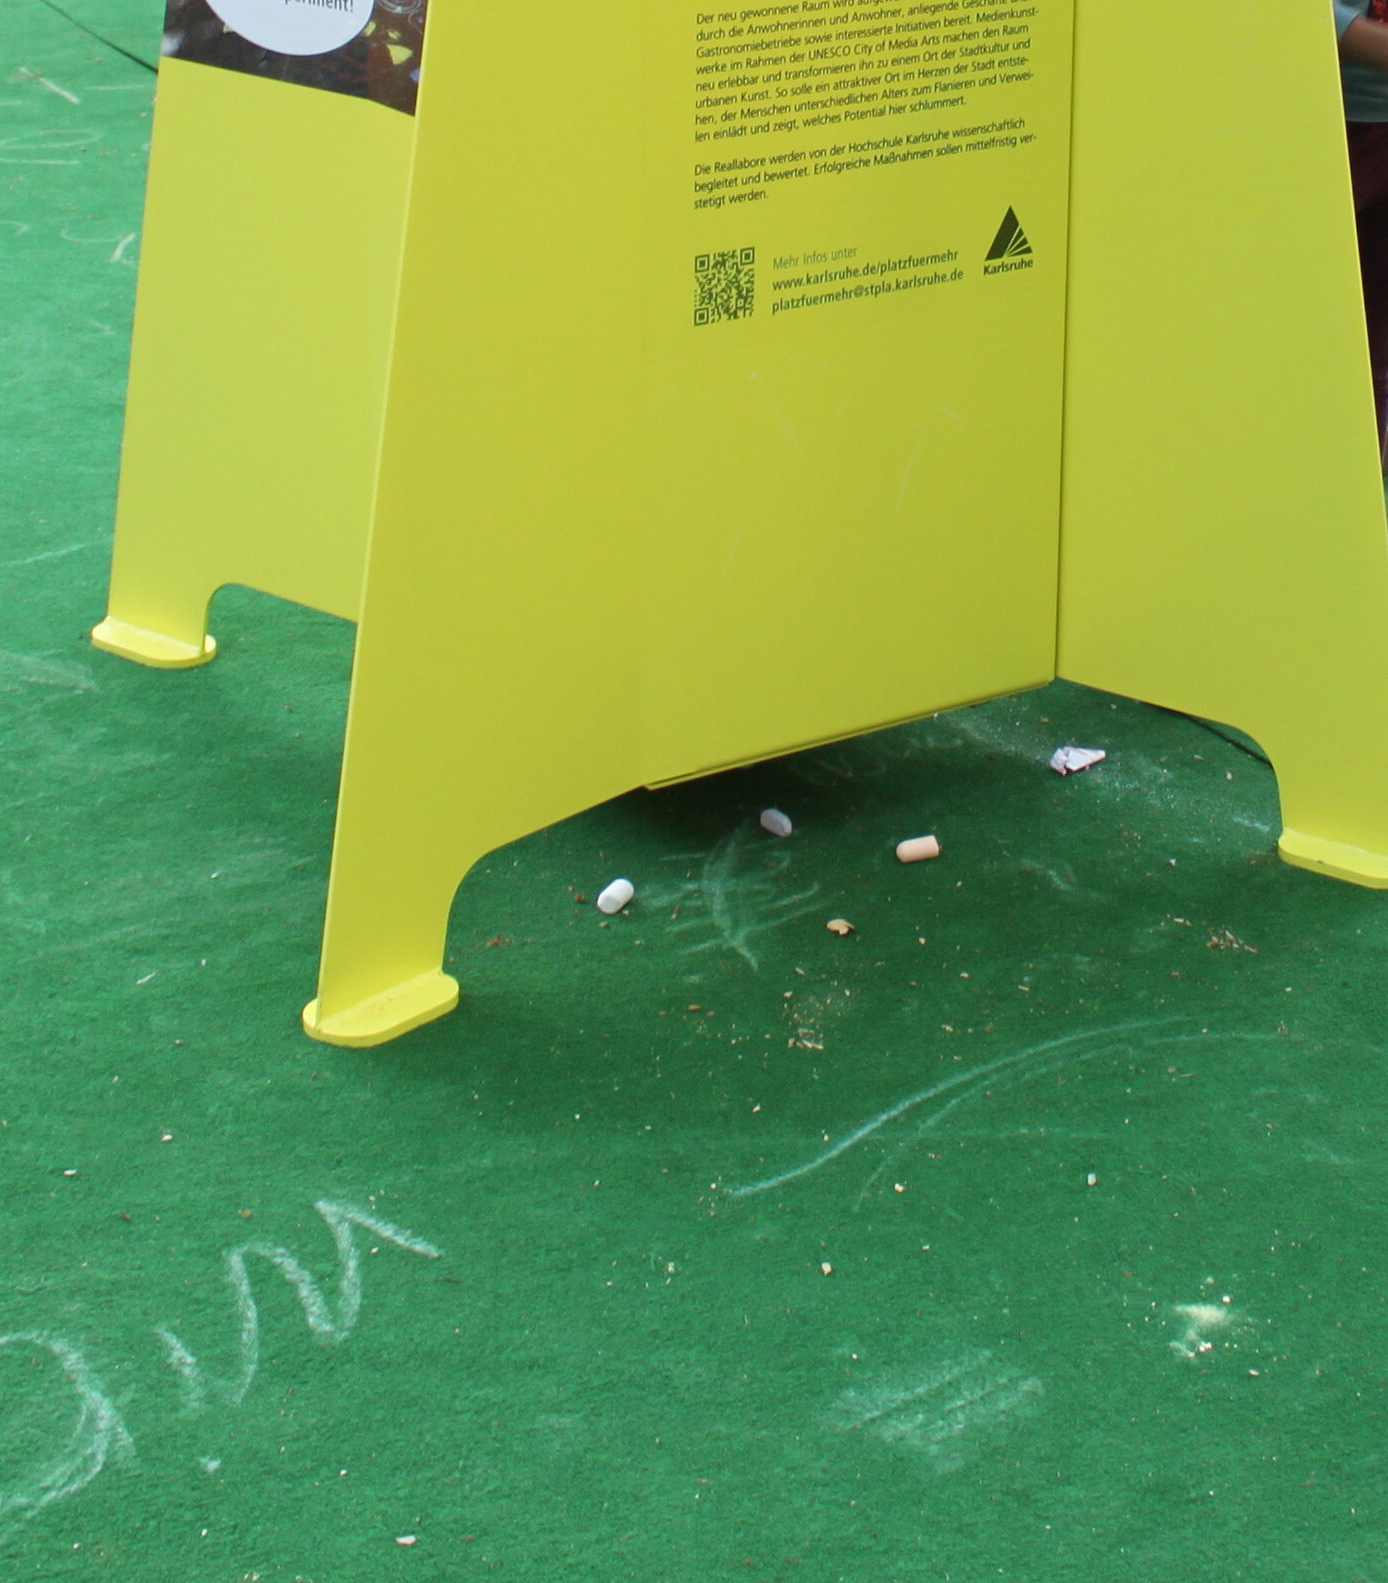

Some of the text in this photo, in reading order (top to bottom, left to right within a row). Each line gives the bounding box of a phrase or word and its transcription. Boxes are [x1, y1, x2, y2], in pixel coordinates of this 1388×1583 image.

[696, 12, 715, 25] Der
[717, 12, 737, 22] neu
[739, 4, 799, 22] gewonnene
[801, 0, 830, 12] Raum
[696, 6, 1038, 58] Gastronomiebetriebe sowie interessierte Initiativen bereit. Medienkunst-
[694, 95, 968, 142] len einlädt und zeigt, welches Potential hier schlummert.
[694, 117, 1025, 176] Die Reallabore werden von der Hochschule Karlsruhe wissenschaftlich
[694, 189, 768, 209] stetigt werden.
[772, 247, 857, 270] Mehr Infos unter
[772, 248, 958, 291] www.karlsruhe.de/platzfuermehr
[983, 258, 1033, 275] Karlsruhe
[772, 267, 963, 316] platzfuermehr@stpla.karlsruhe.de
